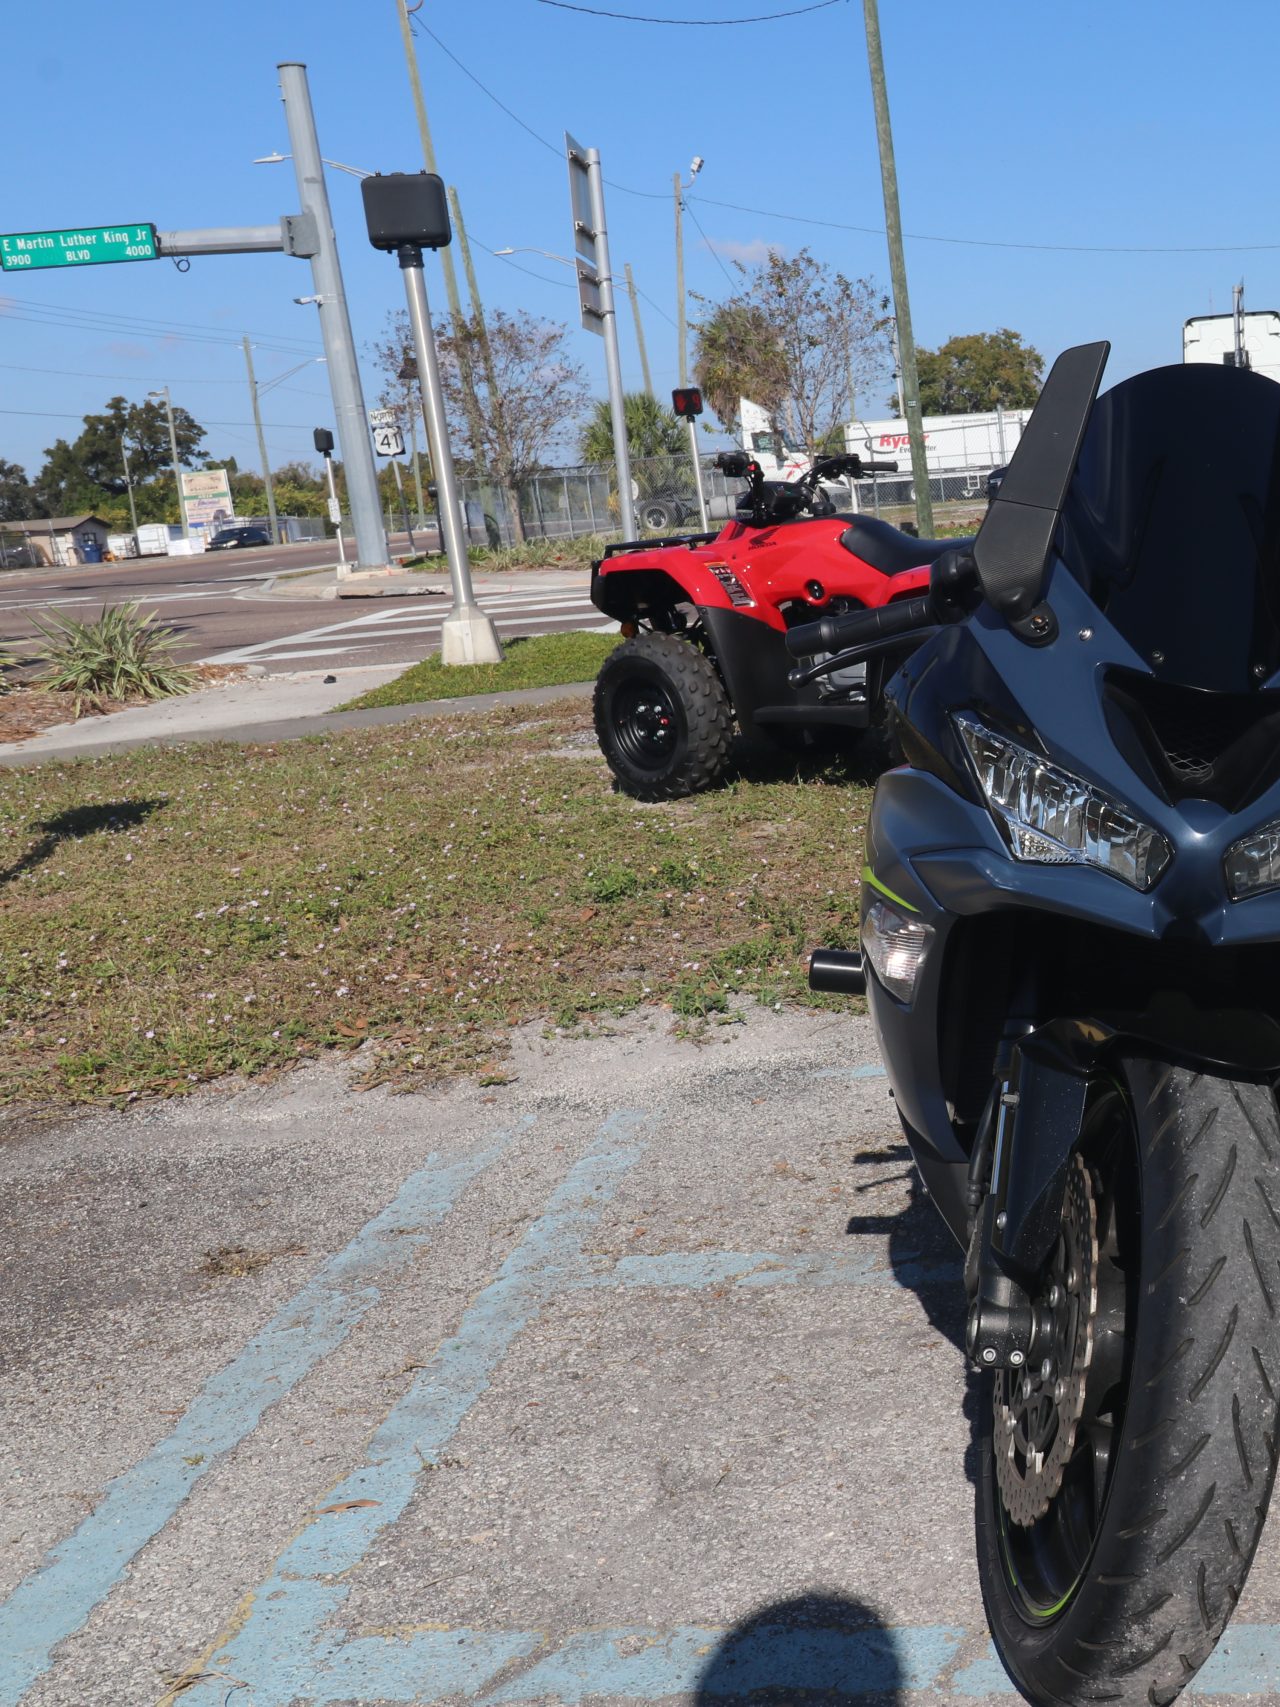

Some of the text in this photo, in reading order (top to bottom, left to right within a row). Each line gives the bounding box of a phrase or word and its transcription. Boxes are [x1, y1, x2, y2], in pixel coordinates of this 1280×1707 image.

[3, 229, 147, 251] E Martin Luther King Jr
[6, 245, 151, 266] 3900 BLVD 4000
[380, 434, 399, 449] 41
